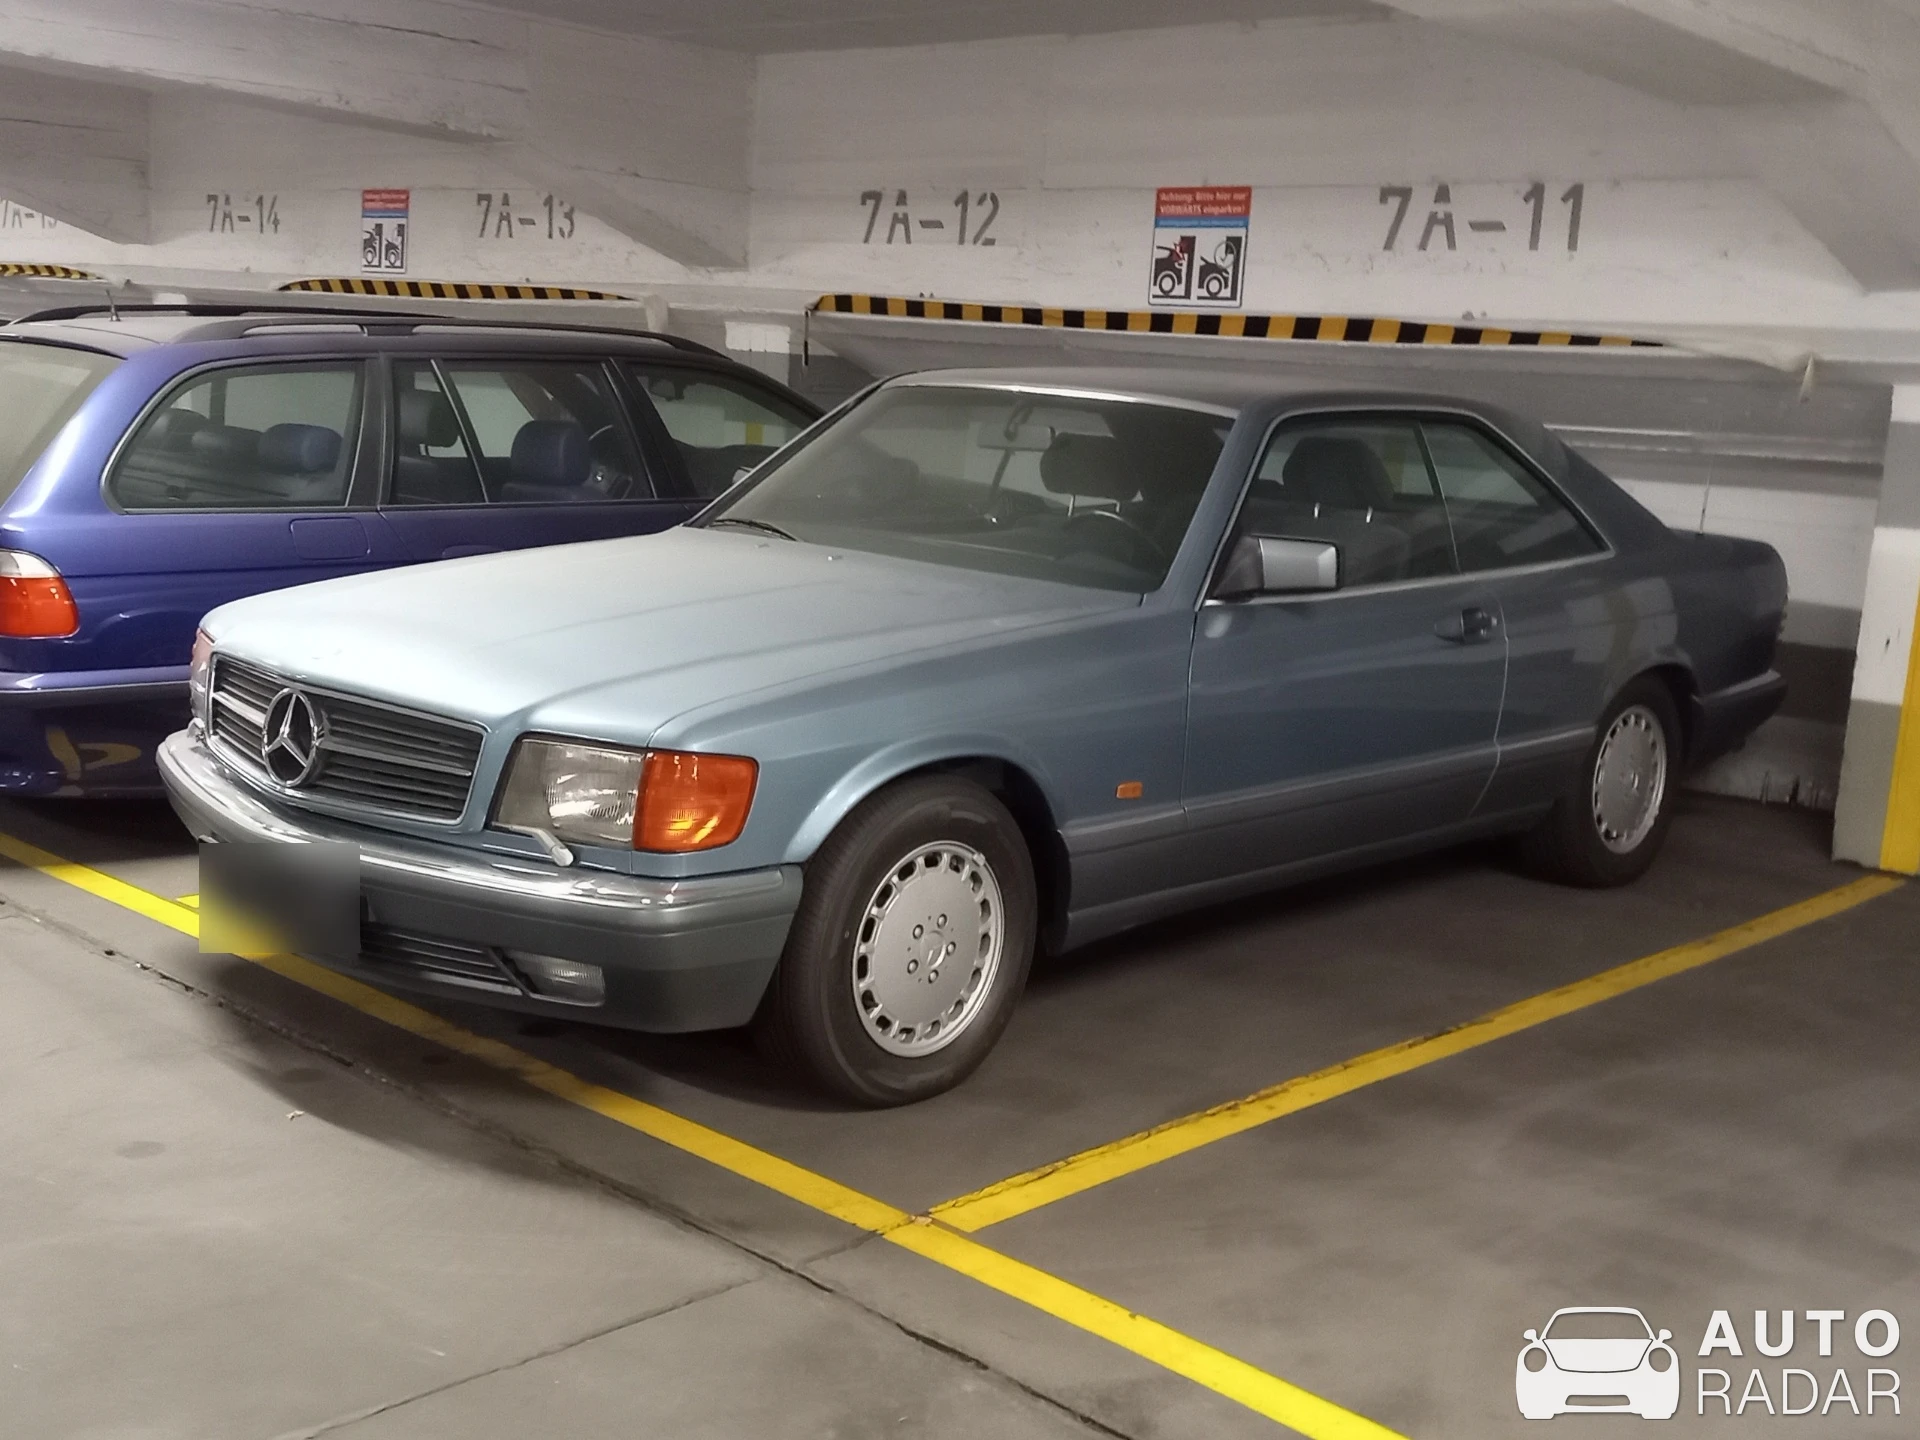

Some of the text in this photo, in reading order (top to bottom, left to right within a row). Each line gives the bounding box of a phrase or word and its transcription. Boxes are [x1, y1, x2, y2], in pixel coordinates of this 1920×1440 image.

[207, 194, 281, 234] 7A-14
[477, 192, 575, 239] 7A-13
[860, 189, 1000, 246] 7A-12
[1379, 183, 1585, 251] 7A-11
